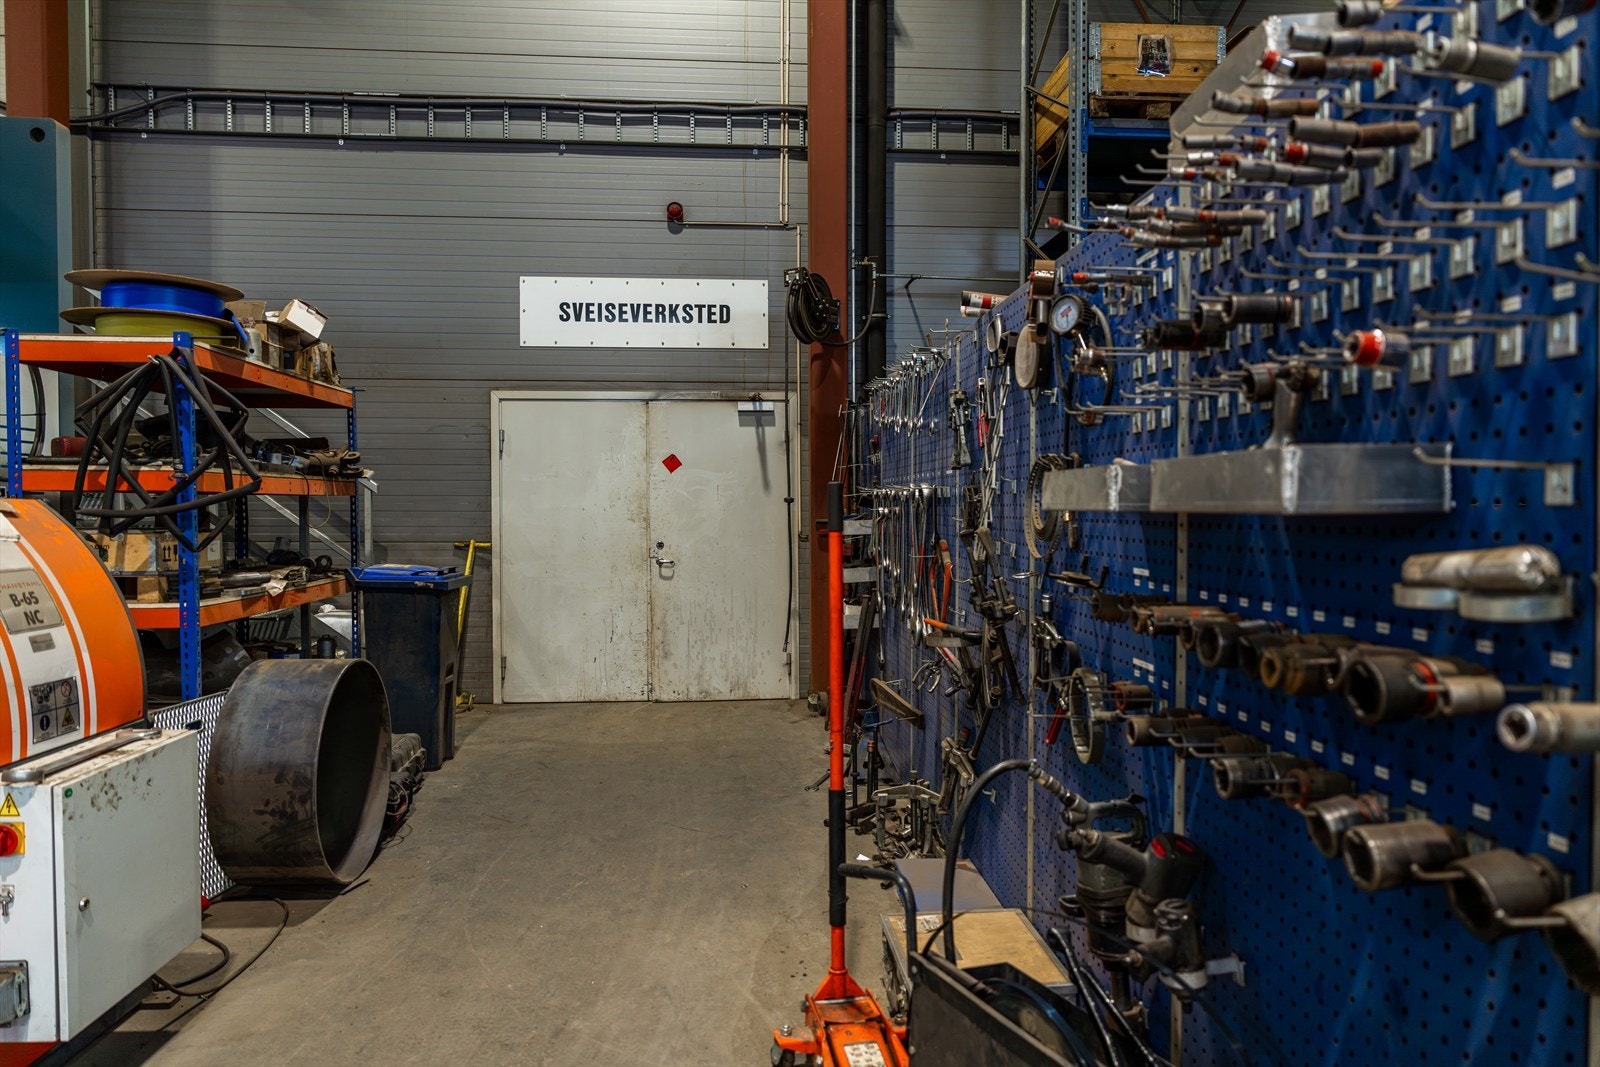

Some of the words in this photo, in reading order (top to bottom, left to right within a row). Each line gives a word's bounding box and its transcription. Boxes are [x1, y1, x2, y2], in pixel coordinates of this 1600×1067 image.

[558, 301, 731, 324] SVEISEVERKSTED
[9, 591, 39, 607] B-65
[23, 609, 44, 626] NC
